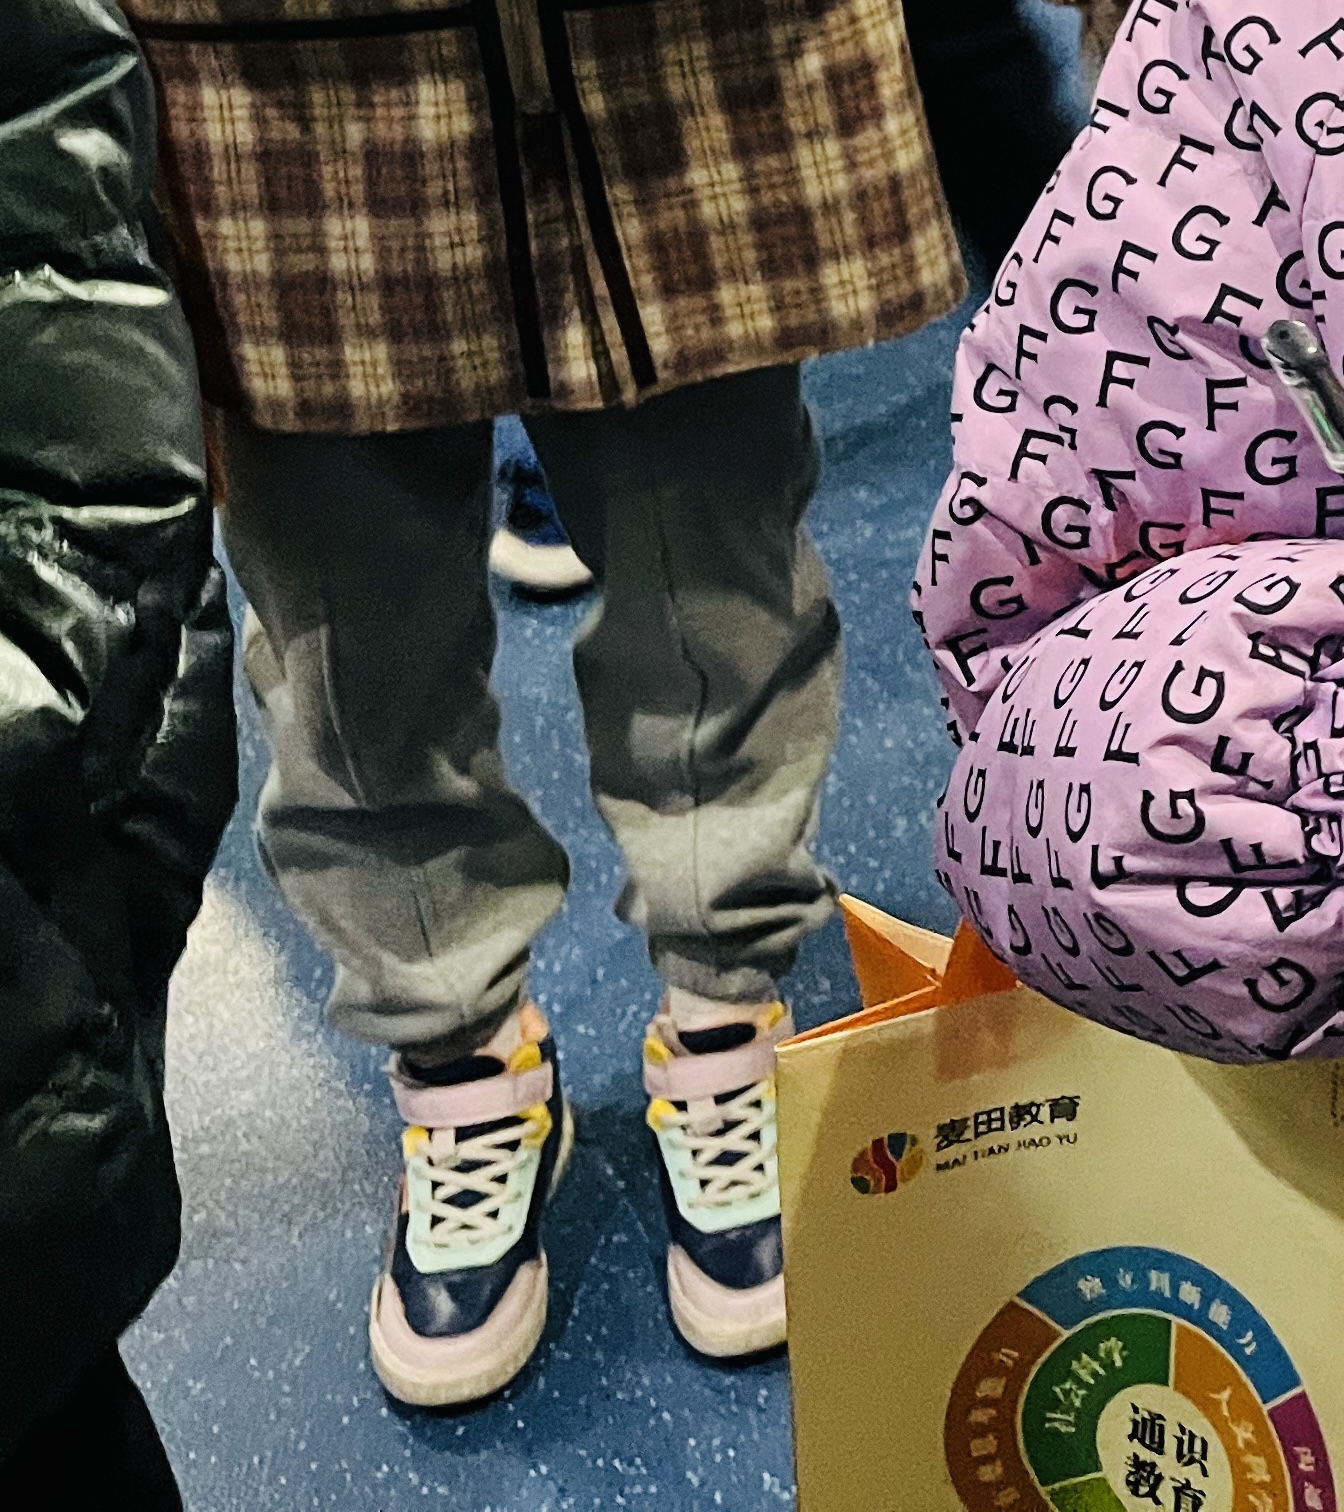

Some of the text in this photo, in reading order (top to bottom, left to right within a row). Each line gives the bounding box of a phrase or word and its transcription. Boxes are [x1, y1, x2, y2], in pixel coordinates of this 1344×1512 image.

[1224, 16, 1281, 75] G
[1137, 59, 1190, 114] G
[1157, 134, 1215, 188] F
[1086, 166, 1137, 221] G
[1172, 205, 1230, 261] G
[1112, 240, 1158, 295] F
[1050, 278, 1099, 334] G
[1015, 324, 1048, 381] F
[1096, 350, 1150, 409] F
[973, 361, 1019, 413] G
[1205, 377, 1247, 431] F
[1008, 428, 1065, 483] F
[1136, 420, 1186, 471] G
[1244, 429, 1299, 485] G
[1041, 495, 1091, 550] G
[1200, 487, 1244, 529] F
[970, 576, 1029, 620] G
[1161, 660, 1225, 724] G
[1140, 789, 1205, 844] G
[935, 1095, 1081, 1152] 麦田教育
[1055, 1132, 1078, 1146] YU
[1126, 1402, 1211, 1478] 通识
